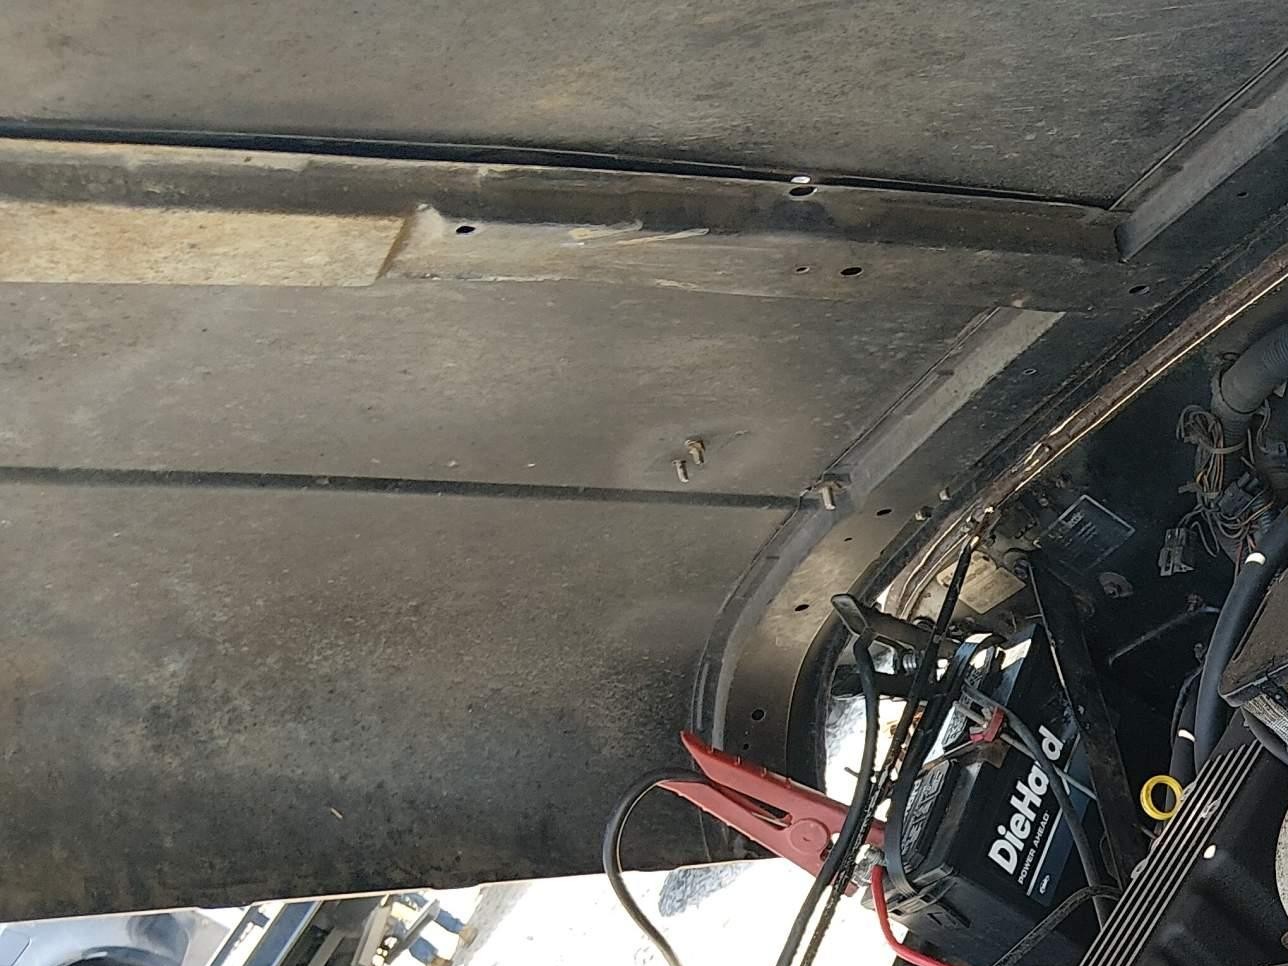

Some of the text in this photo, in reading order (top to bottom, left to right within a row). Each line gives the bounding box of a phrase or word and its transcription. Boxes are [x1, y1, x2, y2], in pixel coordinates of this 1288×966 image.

[988, 725, 1064, 875] DieHad
[1018, 813, 1050, 885] POWER AHEAD
